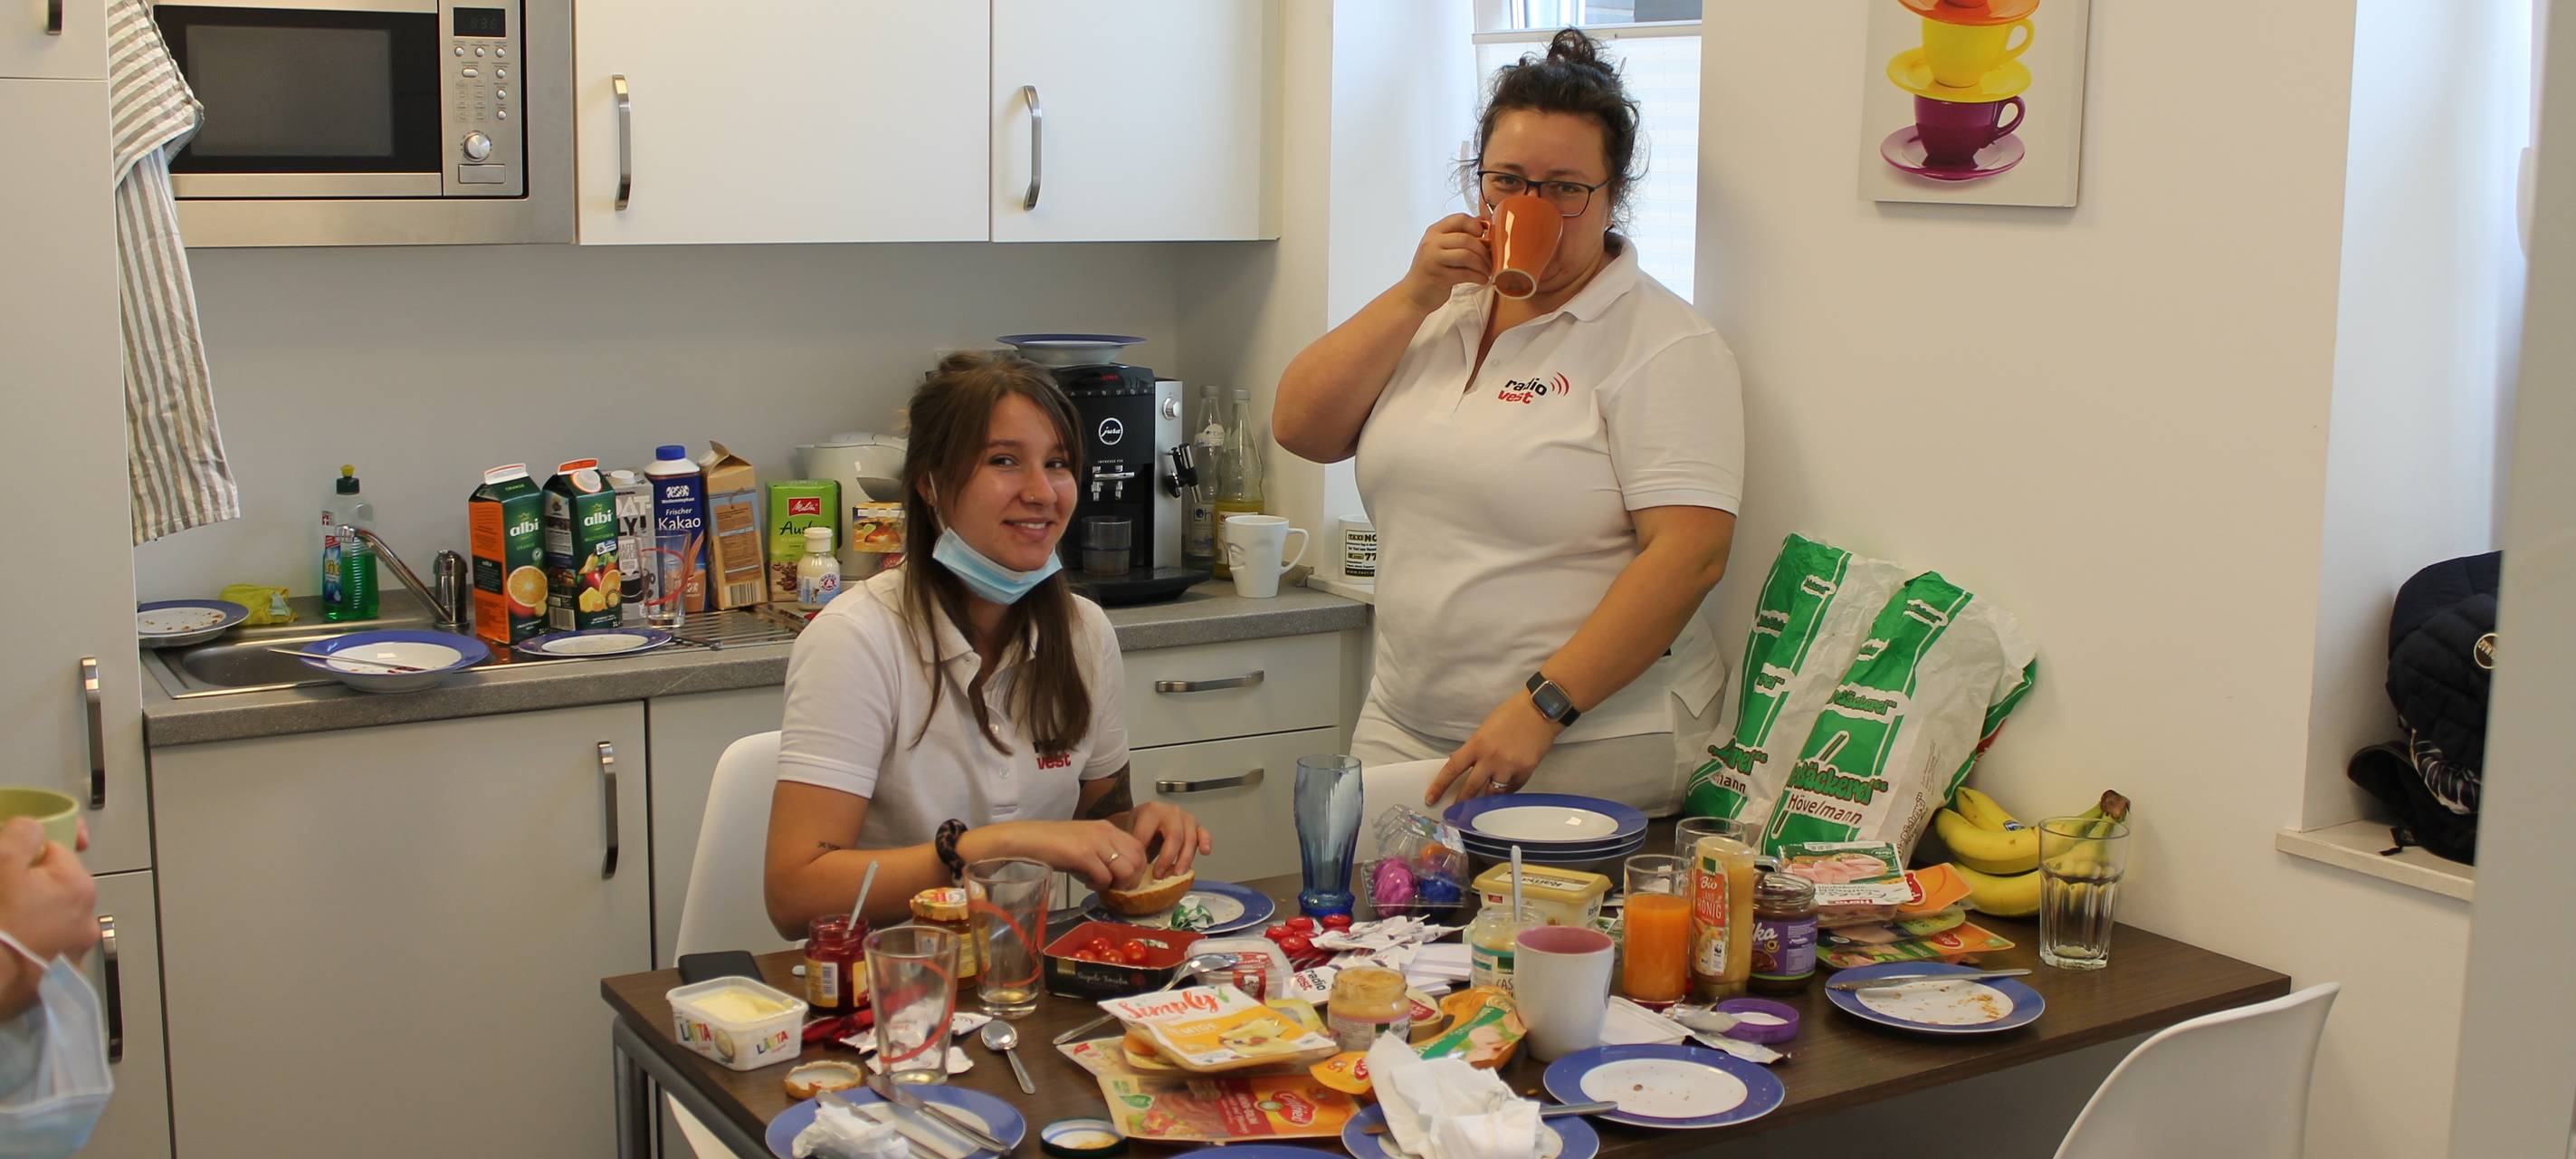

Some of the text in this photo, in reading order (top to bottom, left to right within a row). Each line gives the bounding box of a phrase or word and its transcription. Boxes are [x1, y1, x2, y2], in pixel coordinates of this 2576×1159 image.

[1505, 378, 1548, 396] radio
[1498, 390, 1533, 404] vest
[584, 510, 613, 526] albi
[665, 507, 692, 515] Frischer
[510, 518, 539, 537] albi
[659, 517, 701, 531] Kakao
[1036, 752, 1071, 770] vest
[1788, 794, 1863, 824] Hövelmann
[1701, 876, 1718, 890] Bio
[1294, 972, 1312, 991] vest
[1305, 970, 1326, 991] radio
[1118, 991, 1218, 1019] Simply
[680, 1020, 711, 1043] LÄTTA
[757, 1030, 788, 1055] LÄTTA
